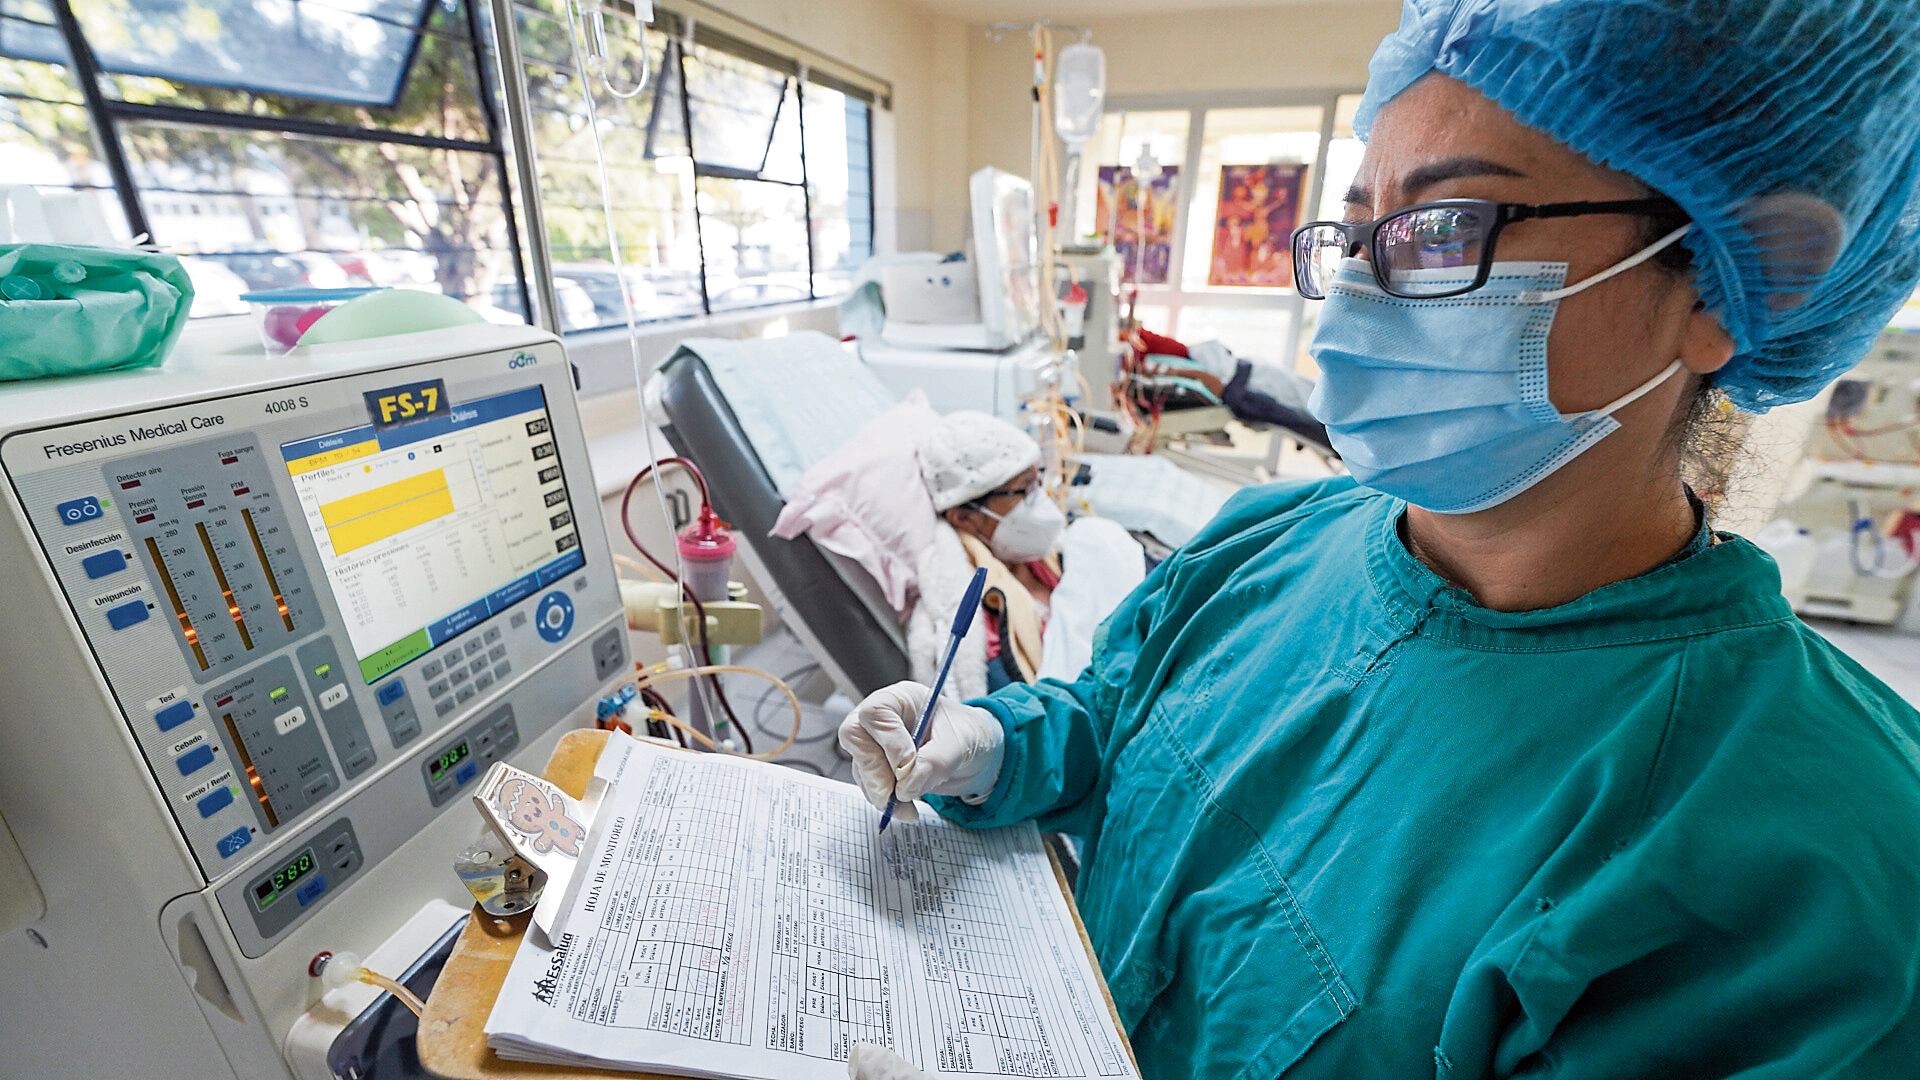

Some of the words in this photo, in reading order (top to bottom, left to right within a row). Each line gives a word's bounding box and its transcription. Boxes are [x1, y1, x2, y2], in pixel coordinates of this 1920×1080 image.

[264, 398, 297, 415] 4008
[299, 396, 309, 408] S
[378, 387, 438, 422] FS-7
[43, 432, 127, 460] Fresenius
[129, 419, 187, 442] Medical
[190, 414, 225, 430] Care
[218, 450, 234, 460] Fuga
[235, 445, 254, 456] sangre
[116, 468, 147, 483] Detector
[149, 465, 162, 474] aire
[180, 484, 206, 496] Presión
[230, 480, 244, 490] PTM
[128, 497, 156, 510] Presión
[182, 492, 208, 503] Venosa
[132, 504, 159, 518] Arterial
[259, 505, 270, 514] 500
[215, 519, 227, 528] 500
[268, 526, 279, 535] 400
[65, 532, 122, 555] Desinfección
[173, 547, 186, 556] 200
[224, 540, 236, 549] 400
[183, 570, 195, 579] 100
[233, 562, 245, 570] 300
[94, 584, 142, 606] Unipunción
[202, 612, 216, 622] -100
[210, 633, 225, 643] -200
[220, 654, 234, 663] -300
[159, 692, 176, 705] Test
[174, 734, 203, 753] Cebado
[185, 784, 205, 802] Inicio
[205, 781, 211, 790] /
[212, 771, 232, 789] Reset
[599, 814, 625, 868] MONITOREO
[275, 855, 309, 890] 280
[594, 868, 607, 883] DE
[583, 884, 602, 913] HOJA
[566, 994, 576, 1012] CARLOS
[571, 974, 582, 994] ALBERTO
[718, 970, 727, 1005] ENFERMERIA
[577, 997, 587, 1017] FECHA:
[587, 986, 602, 1019] DIALIZADOR:
[609, 989, 622, 1024] SOBREPESO
[598, 1004, 607, 1021] BAÑO:
[651, 1011, 659, 1026] PESO
[661, 1001, 671, 1028] BALANCE
[884, 1000, 893, 1038] ENFERMERIA
[938, 1047, 946, 1068] FECHA:
[945, 1033, 956, 1069] DIALIZADOR:
[963, 1036, 973, 1069] SOBREPESO
[1005, 1047, 1015, 1072] BALANCE
[1049, 1057, 1058, 1074] NOTAS
